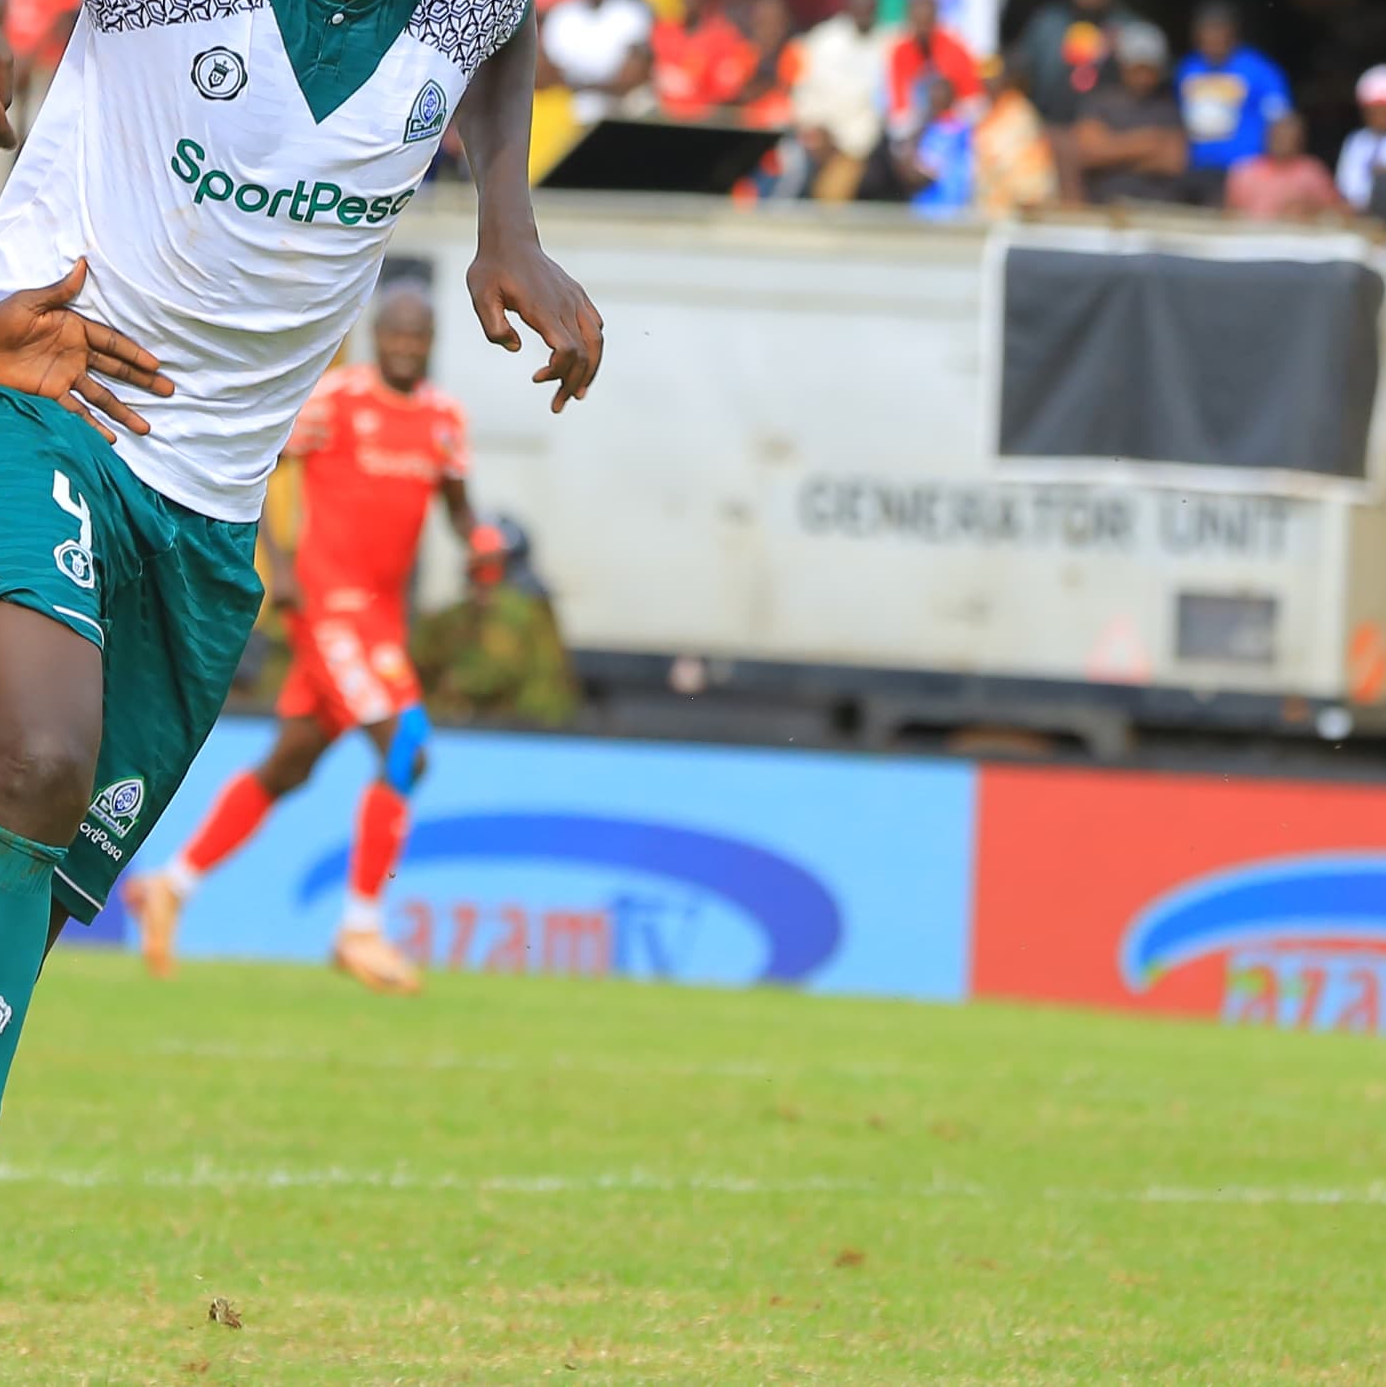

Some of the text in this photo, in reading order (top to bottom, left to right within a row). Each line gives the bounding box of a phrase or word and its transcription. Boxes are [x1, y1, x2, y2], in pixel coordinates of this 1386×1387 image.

[171, 138, 415, 225] SportPesa
[798, 476, 1289, 558] GENERATOR UNIT
[79, 822, 123, 861] ortPesa
